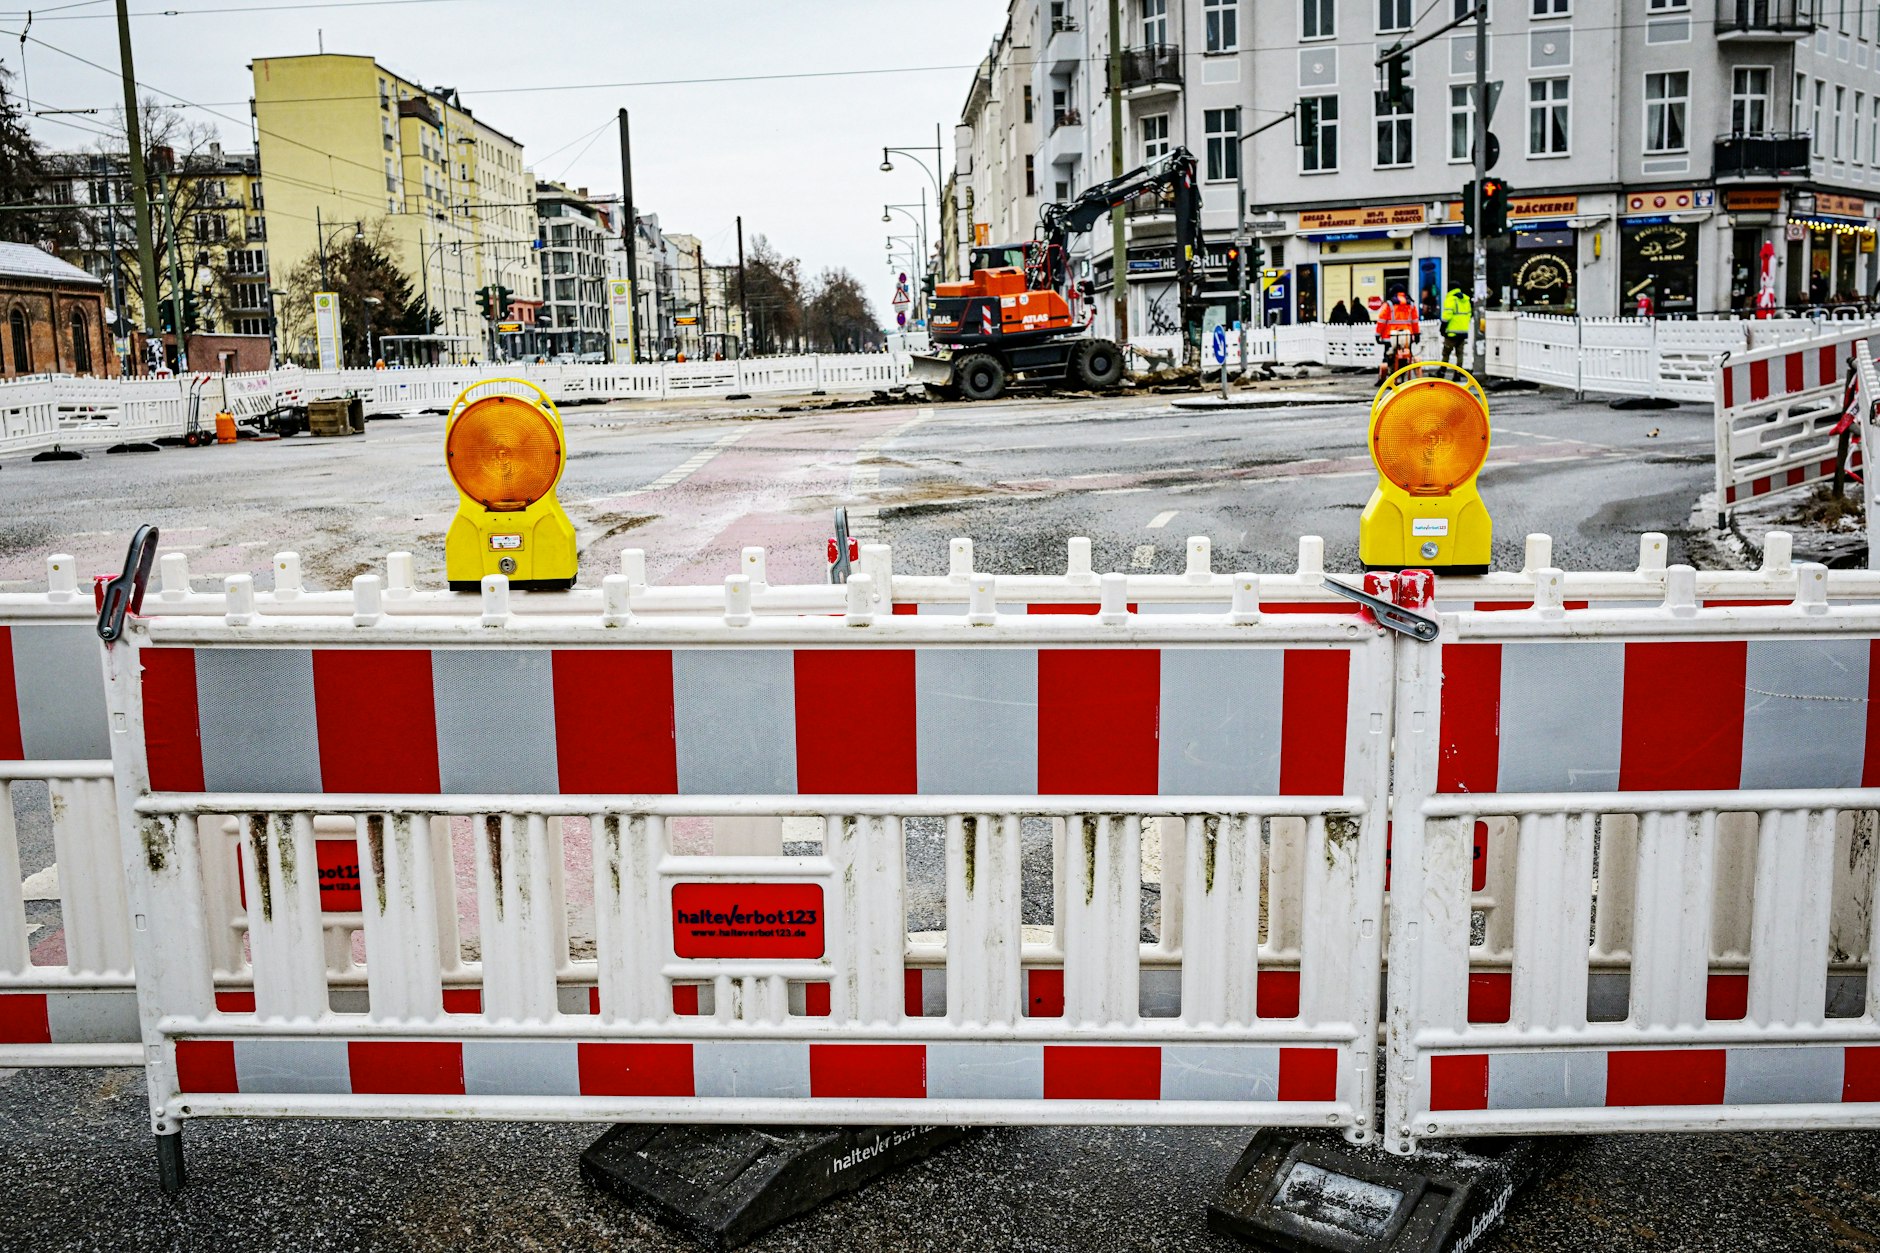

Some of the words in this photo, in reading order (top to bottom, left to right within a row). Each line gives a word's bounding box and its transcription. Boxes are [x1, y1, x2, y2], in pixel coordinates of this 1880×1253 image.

[1515, 202, 1574, 214] BÄCKEREI
[1303, 214, 1325, 222] BREAD
[1363, 217, 1388, 225] SNACKS
[1392, 215, 1422, 223] TOBACCO
[1319, 219, 1356, 228] BREAKFAST
[1192, 254, 1247, 268] BRILL
[1022, 313, 1049, 324] ATLAS
[677, 904, 817, 926] halteverbot123
[691, 928, 806, 937] www.halteverbot123.de
